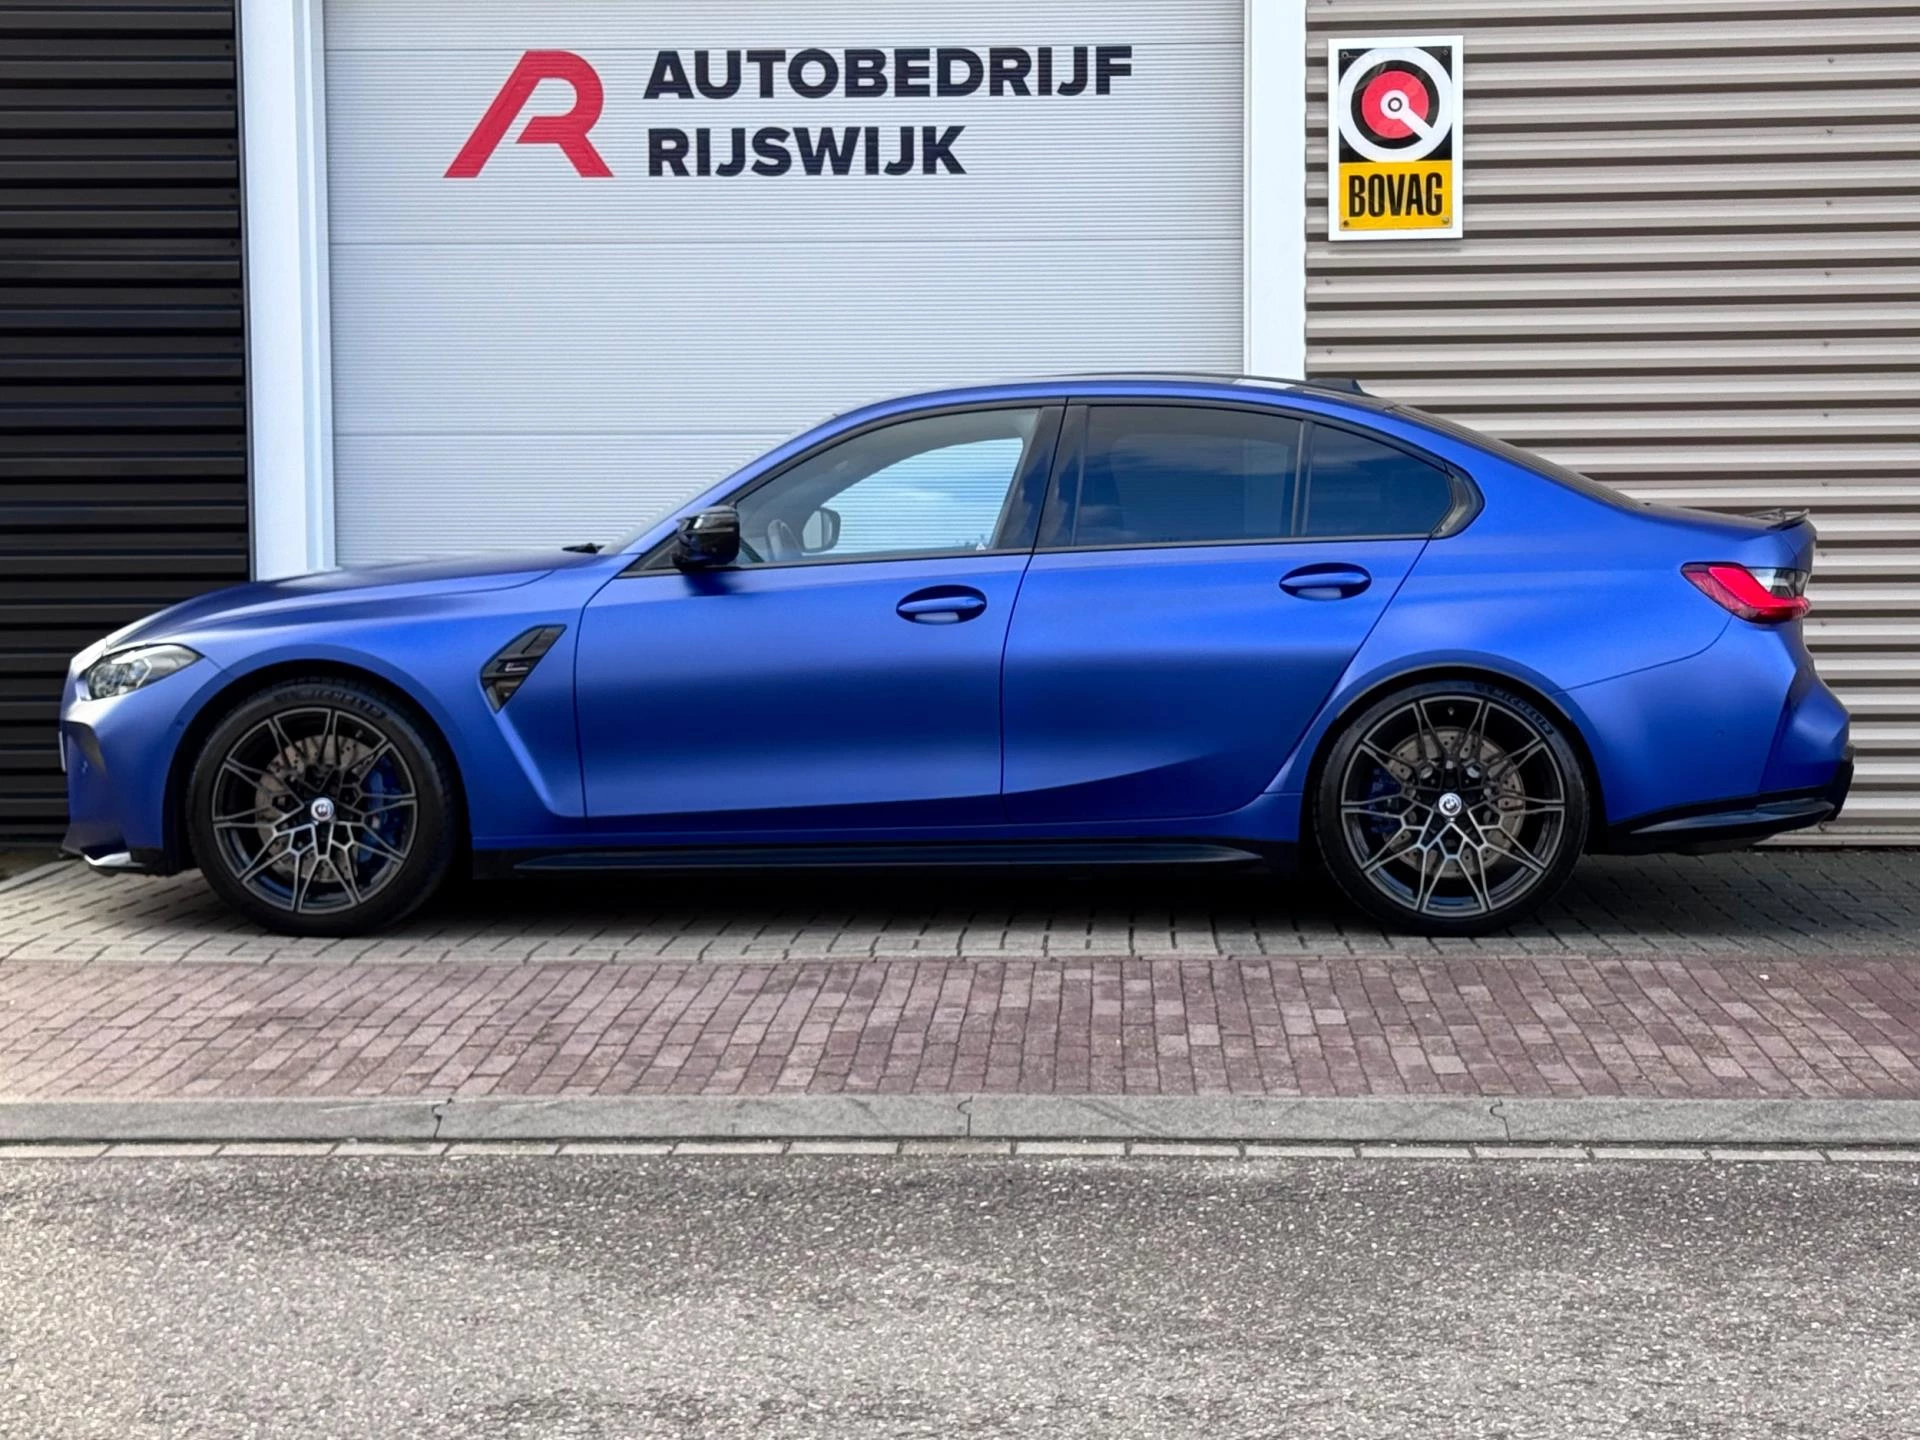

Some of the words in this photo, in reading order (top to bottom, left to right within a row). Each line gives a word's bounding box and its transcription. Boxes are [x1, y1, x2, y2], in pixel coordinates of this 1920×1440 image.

[644, 46, 1132, 99] AUTOBEDRIJF
[648, 126, 967, 177] RIJSWIJK
[1348, 172, 1443, 217] BOVAG
